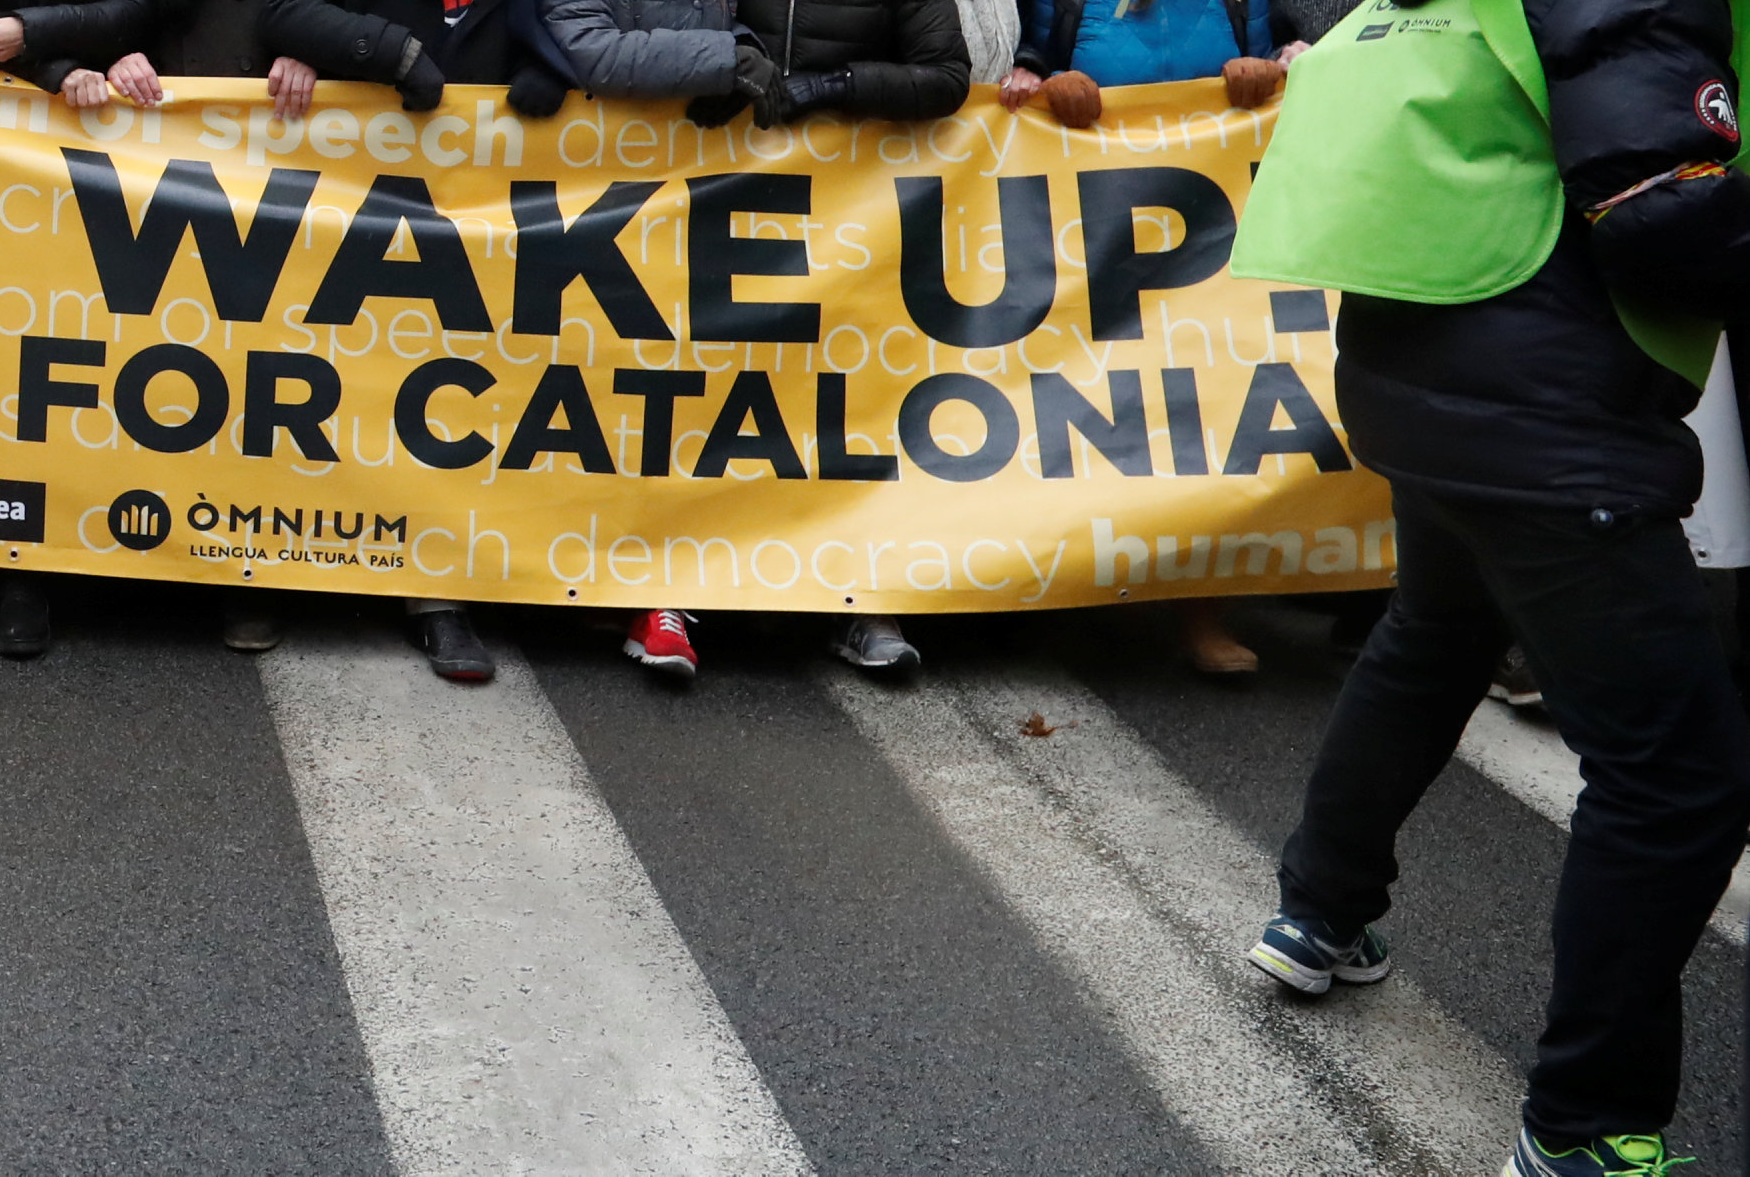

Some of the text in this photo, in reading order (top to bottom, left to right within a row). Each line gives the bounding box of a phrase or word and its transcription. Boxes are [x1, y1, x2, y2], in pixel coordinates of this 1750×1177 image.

[197, 99, 524, 167] speech
[61, 147, 822, 343] WAKE
[893, 160, 1330, 349] UP
[17, 335, 341, 463] FOR
[393, 358, 1352, 483] CATALONIA
[186, 492, 407, 544] ÒMNIUM
[188, 543, 405, 569] LLENGUA CULTURA PAÍS
[549, 514, 1065, 604] democracy
